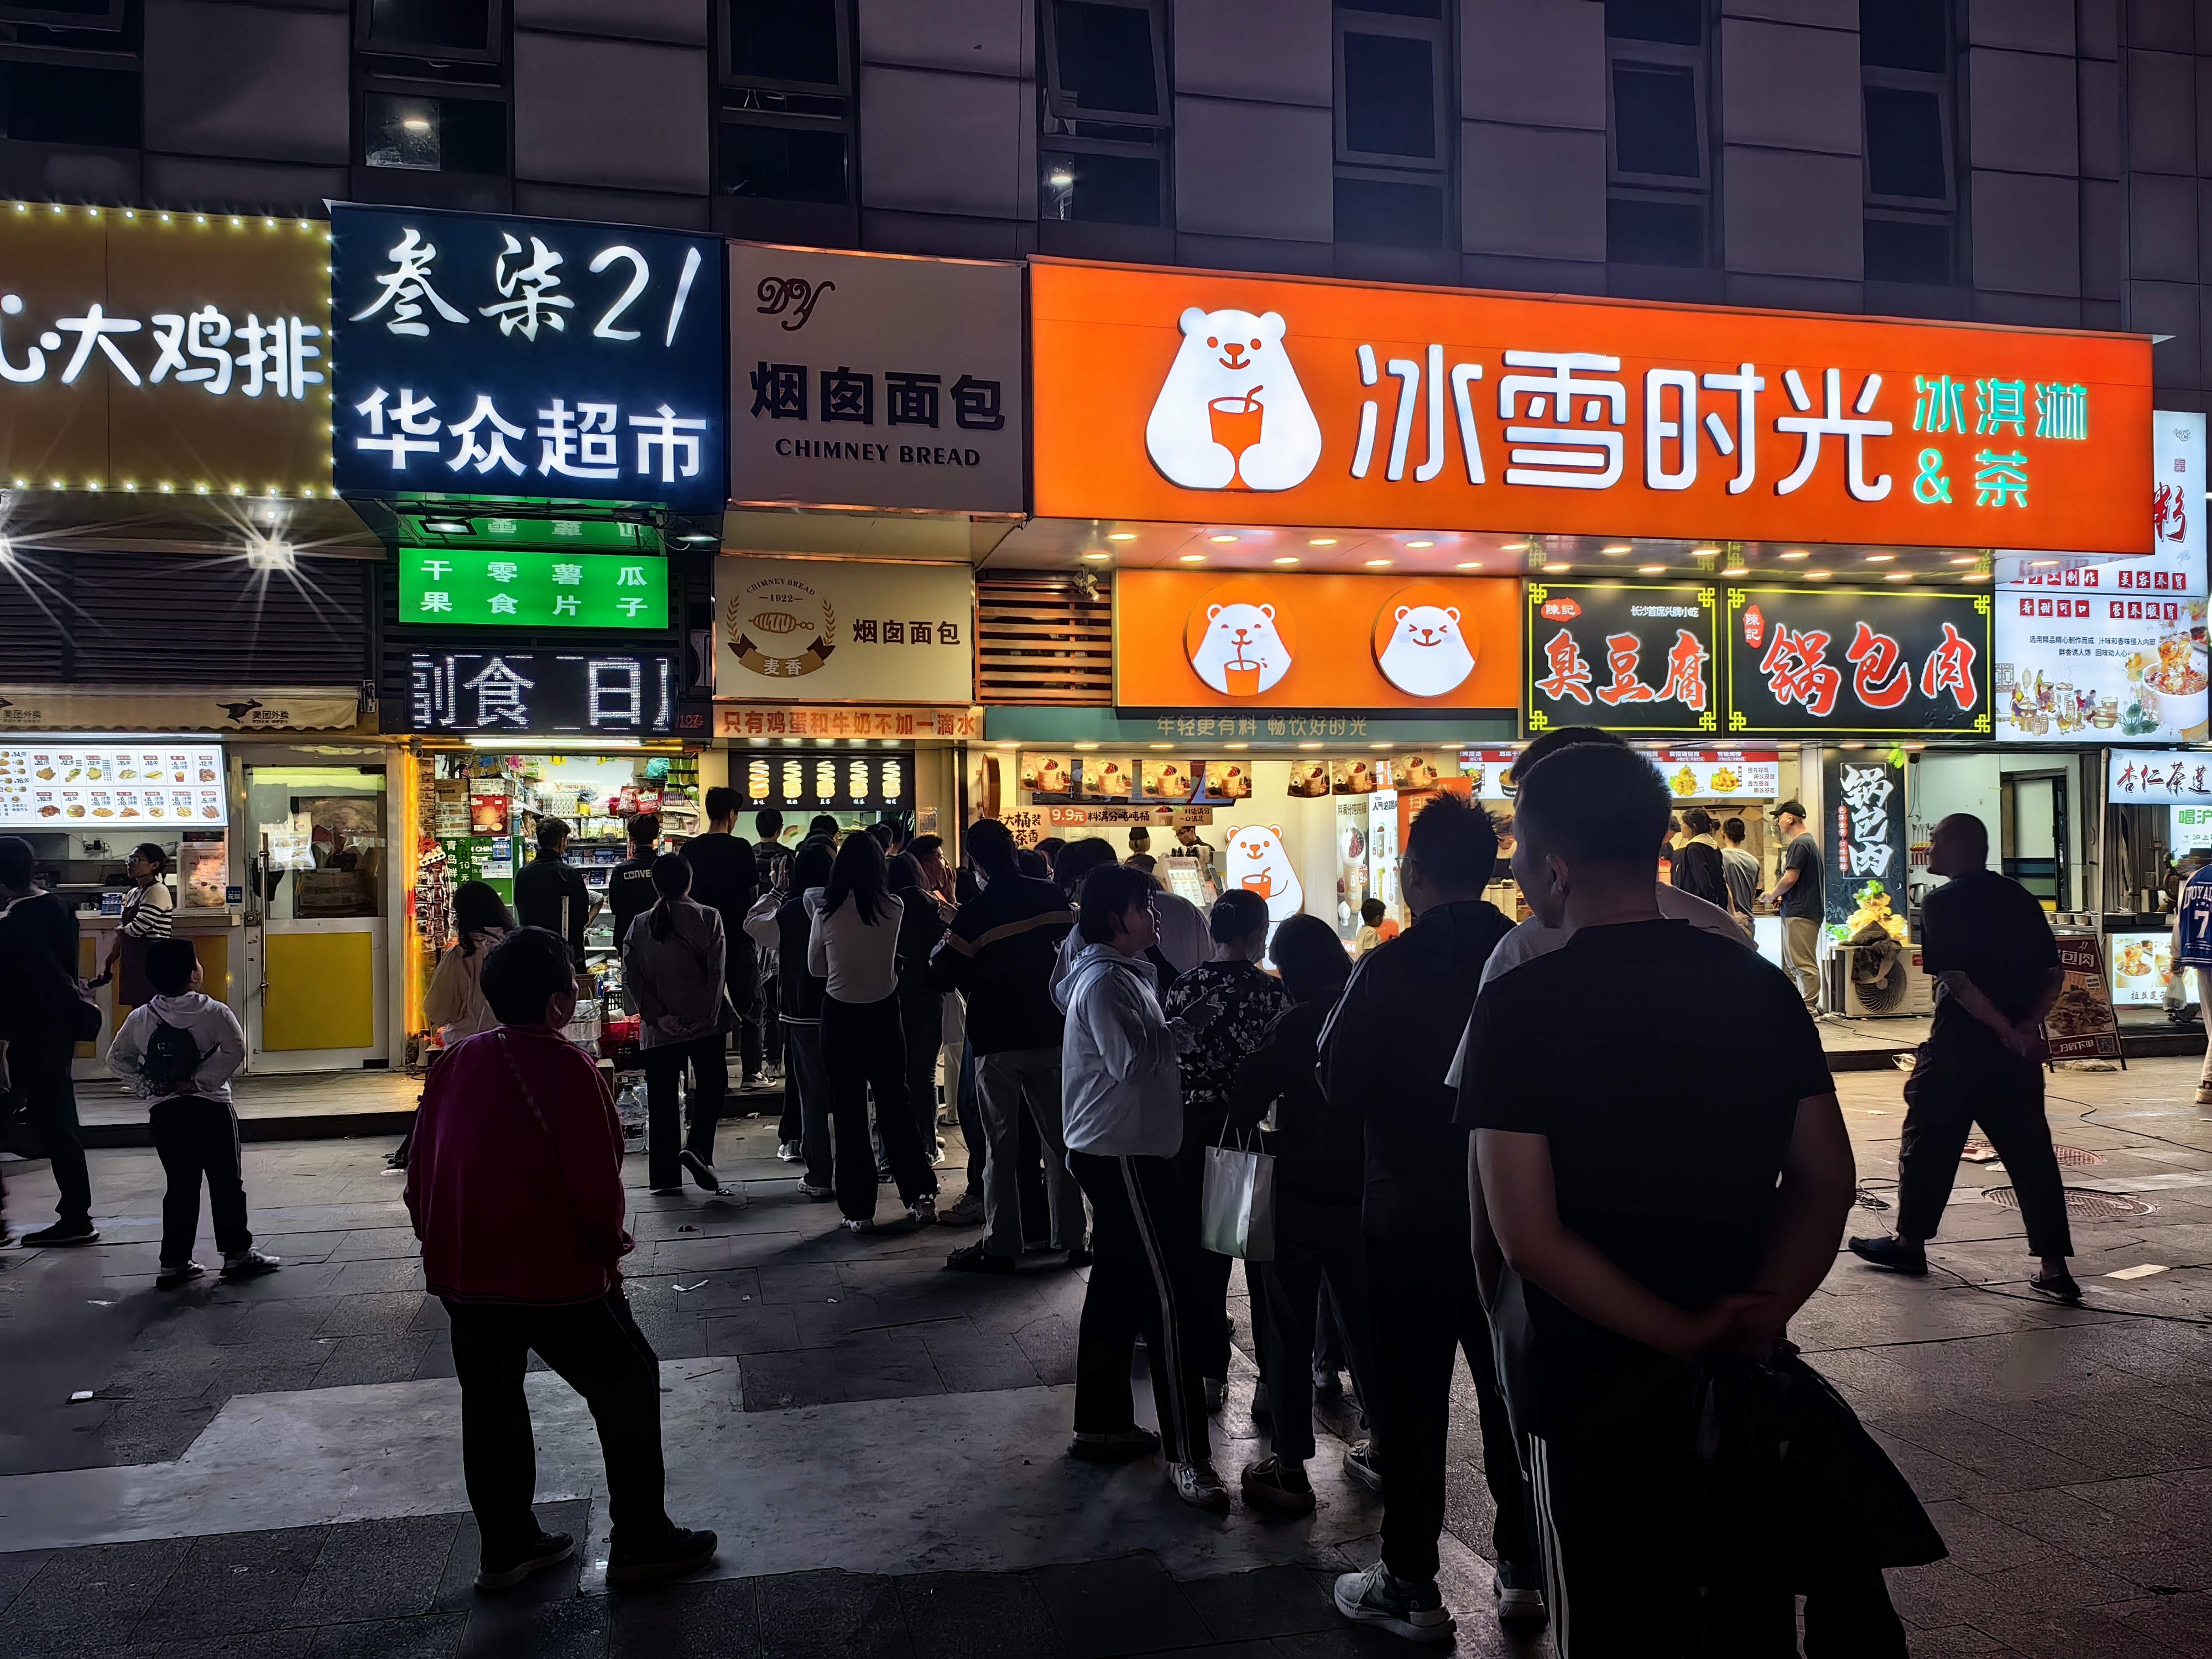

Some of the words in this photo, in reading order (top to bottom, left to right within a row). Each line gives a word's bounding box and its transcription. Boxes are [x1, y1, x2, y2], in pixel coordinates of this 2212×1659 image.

[348, 226, 702, 348] 叁柒21
[749, 361, 1005, 431] 烟囱面包
[1912, 374, 2088, 440] 冰淇淋
[354, 387, 707, 483] 华众超市
[1350, 343, 1893, 502] 冰雪时光
[775, 438, 889, 462] CHIMNEY
[899, 445, 980, 467] BREAD
[1913, 447, 1953, 504] &
[1975, 448, 2028, 508] 茶
[746, 578, 784, 594] CHIMNEY
[787, 578, 816, 597] BREAD
[2120, 571, 2183, 589] 美容养胃
[1630, 606, 1699, 618] 长沙首席头牌小吃
[2021, 600, 2086, 615] 香甜可口
[853, 618, 961, 645] 烟囱面包
[763, 658, 802, 676] 麦香
[1535, 628, 1710, 712] 臭豆腐
[1759, 621, 1977, 717] 锅包肉
[589, 658, 668, 727] 日
[723, 710, 975, 736] 只有鸡蛋和牛奶不加一滴水
[1157, 714, 1257, 737] 年轻更有料
[1267, 716, 1368, 738] 畅饮好时光
[2116, 759, 2212, 796] 杏仁茶莲
[1052, 808, 1084, 822] 9.9元
[1088, 810, 1150, 822] 料满分吨吨桶
[1839, 764, 1894, 877] 锅包肉
[1011, 829, 1039, 846] 茶香
[623, 870, 653, 880] CONVE
[2194, 910, 2209, 938] 7
[2058, 950, 2094, 967] 包肉
